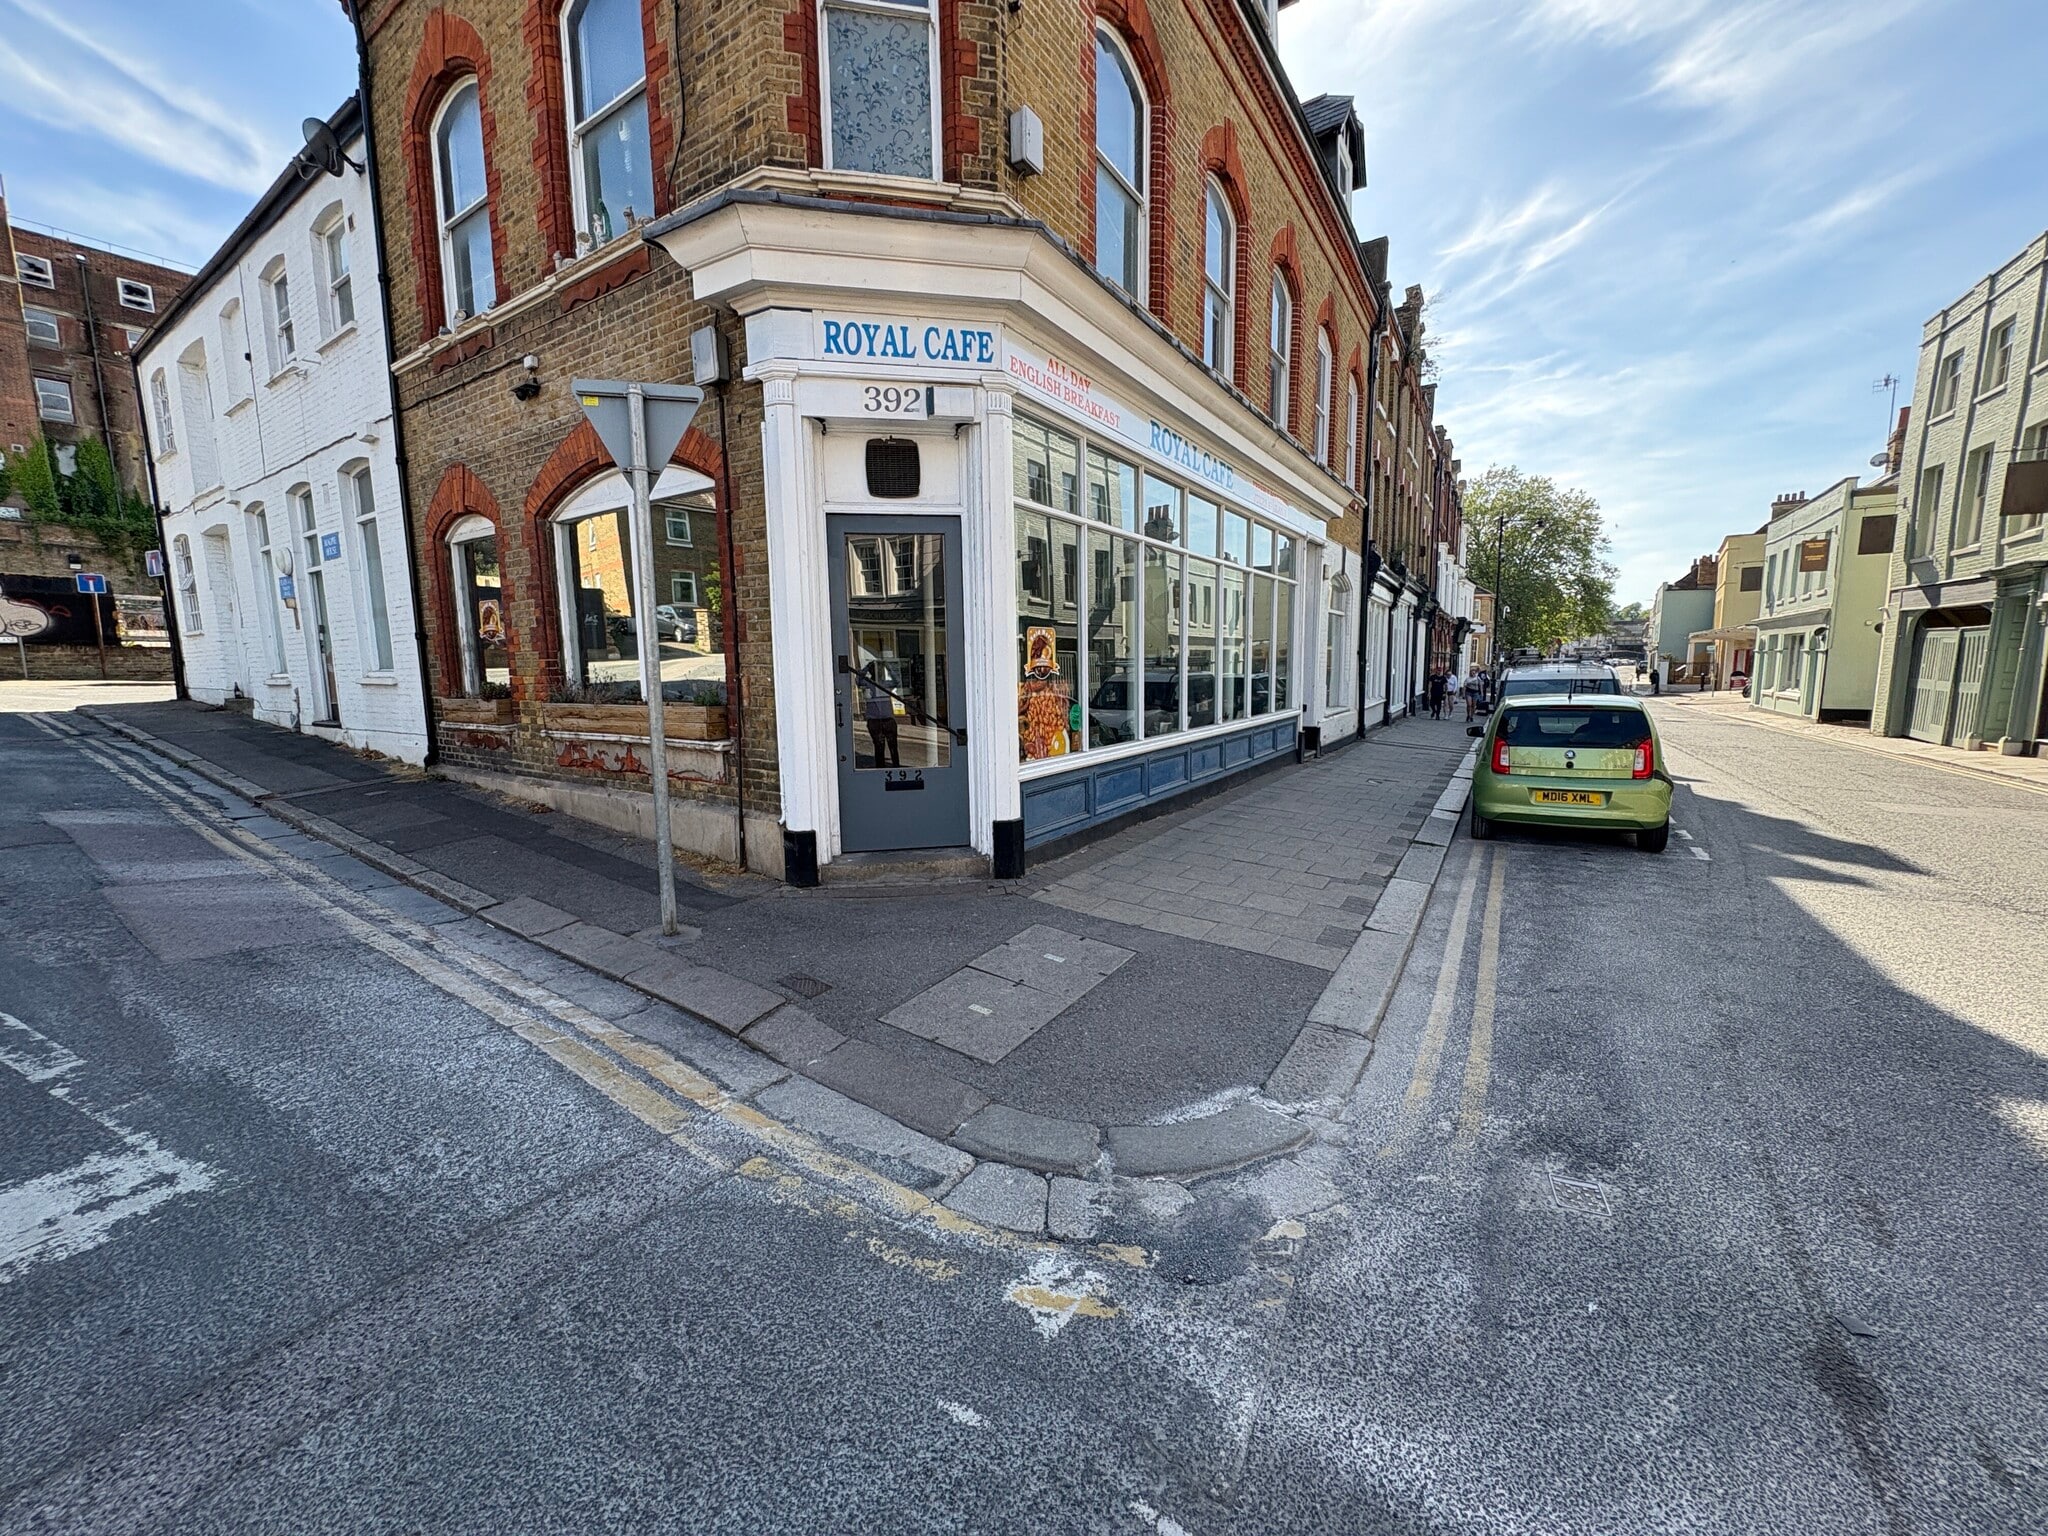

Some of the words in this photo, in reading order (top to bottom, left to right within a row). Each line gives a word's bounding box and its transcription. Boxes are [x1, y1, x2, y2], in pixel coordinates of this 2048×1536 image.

[823, 320, 917, 359] ROYAL
[924, 326, 994, 363] CAFE
[1009, 355, 1061, 397] ENGLISH
[1063, 385, 1121, 428] BREAKFAST
[1047, 358, 1068, 382] ALL
[1070, 370, 1091, 394] DAY
[864, 386, 921, 413] 392
[1150, 419, 1201, 473] ROYAL
[1203, 452, 1234, 489] CAFE
[1542, 791, 1568, 802] MD16
[1571, 792, 1594, 804] XML
